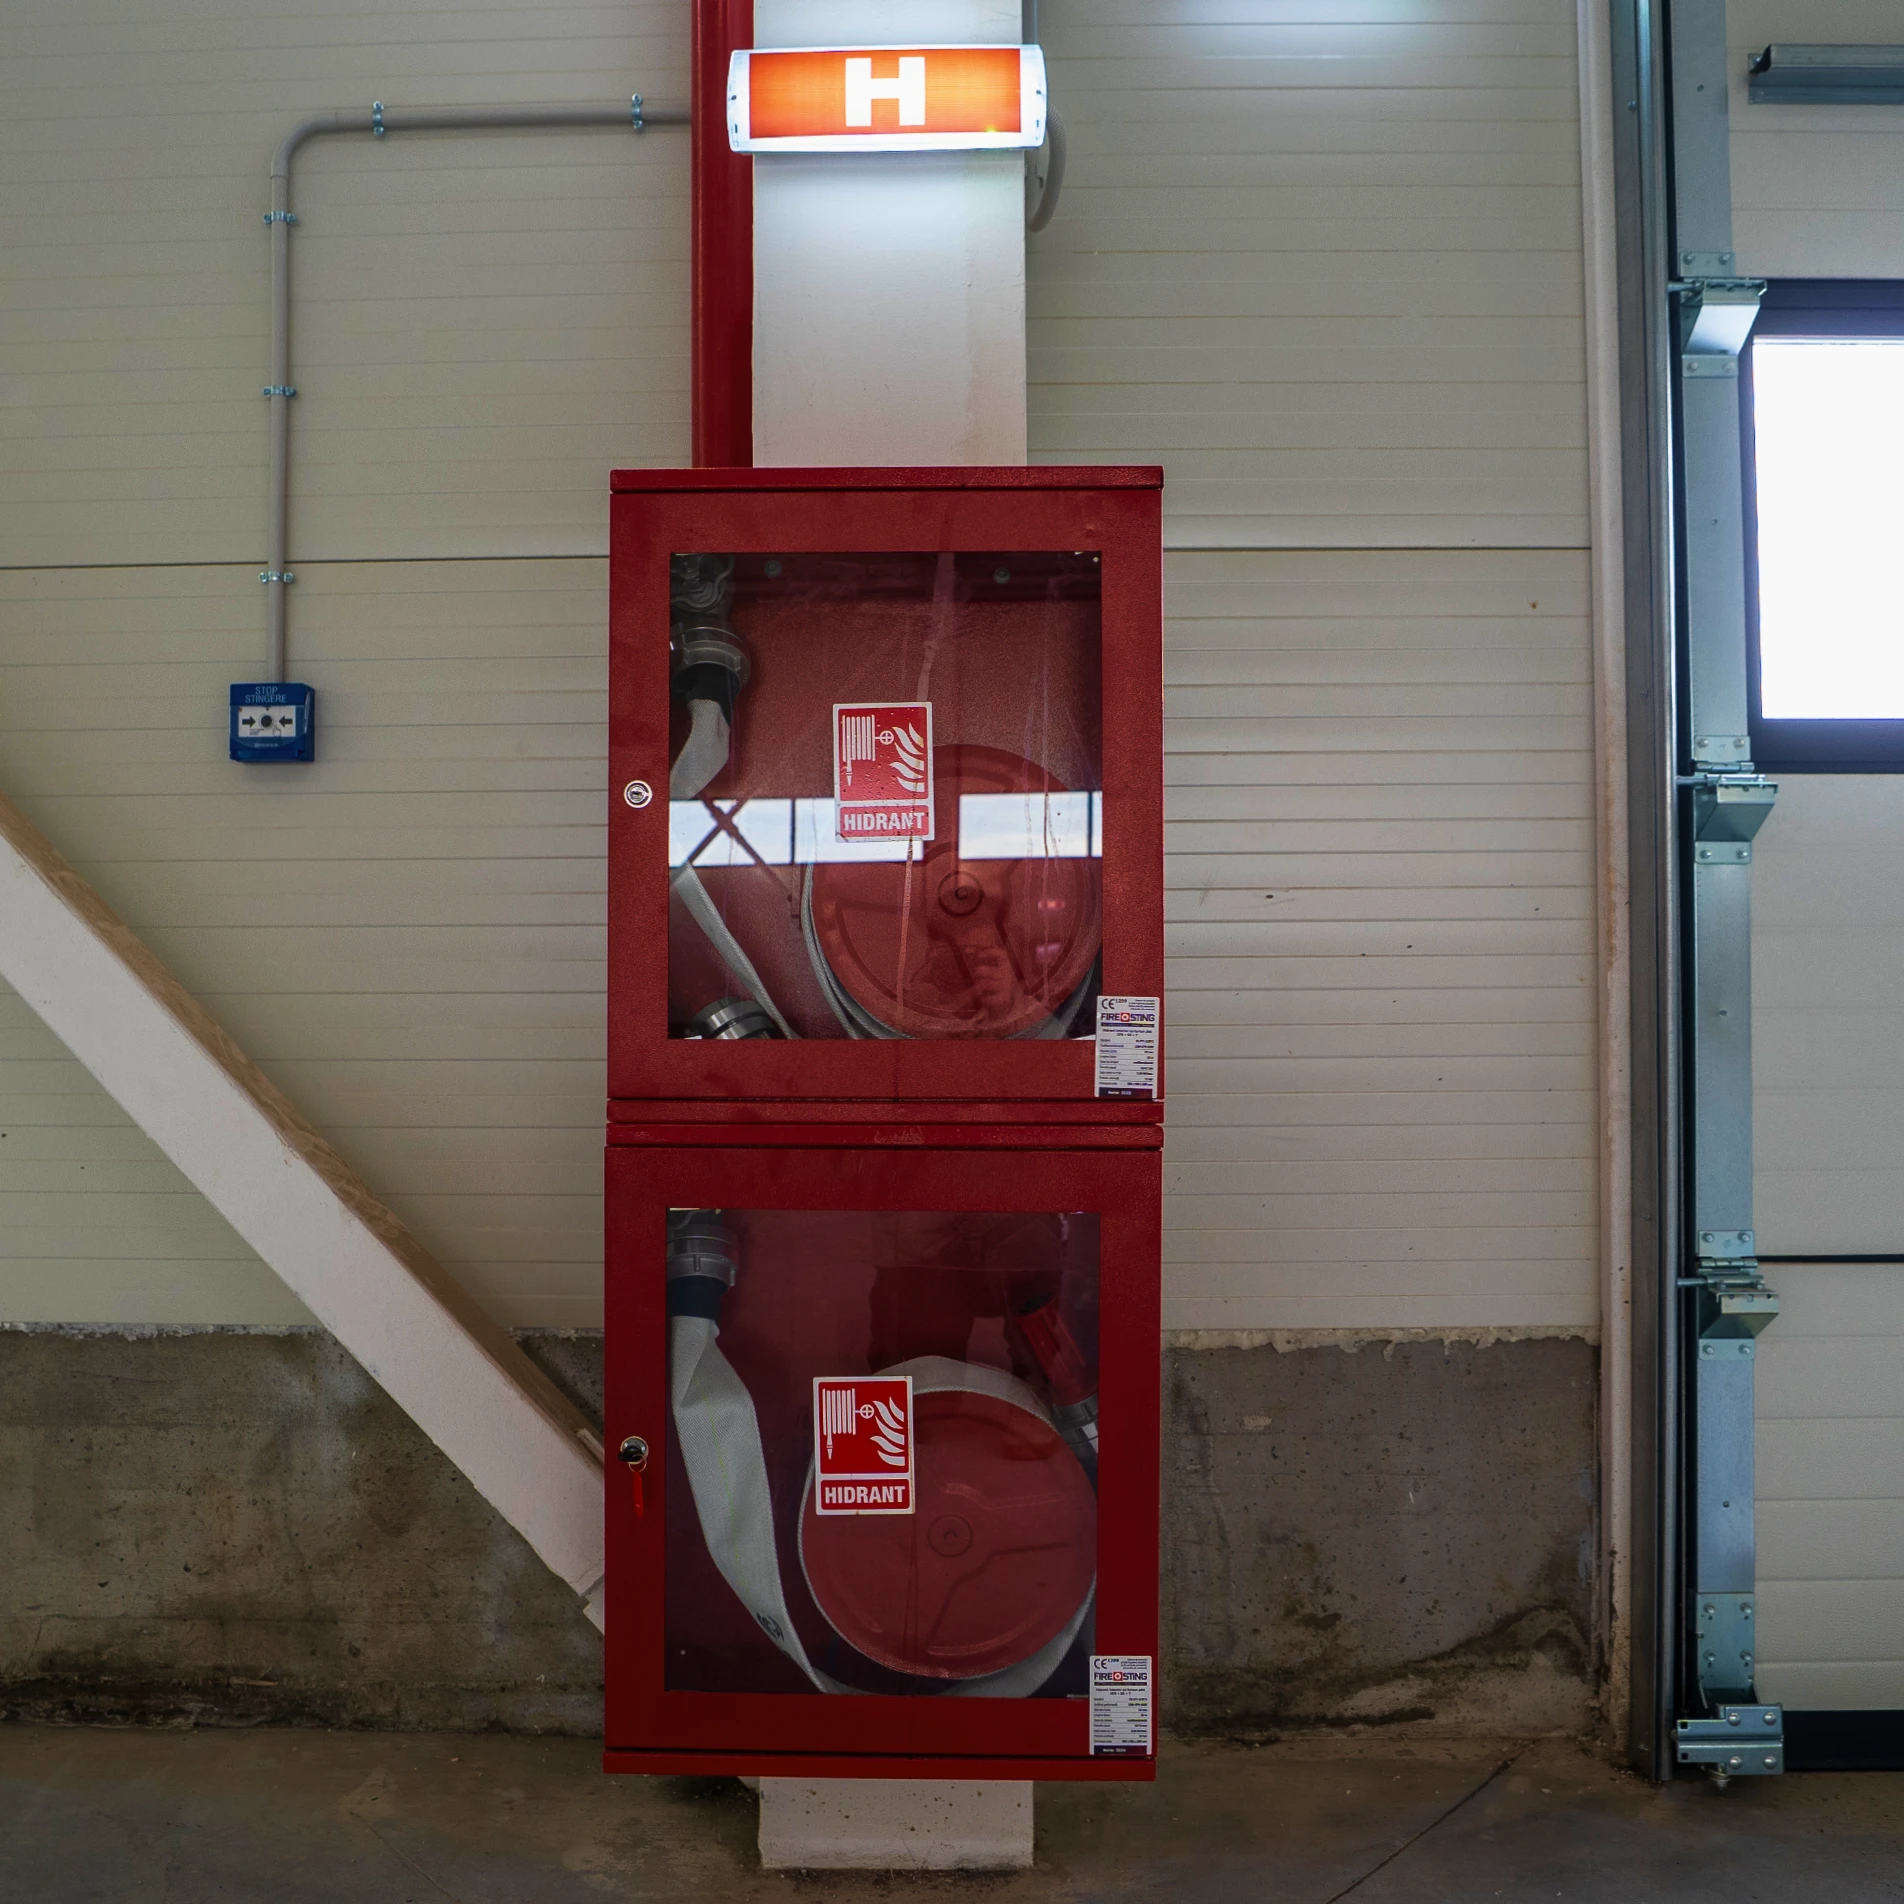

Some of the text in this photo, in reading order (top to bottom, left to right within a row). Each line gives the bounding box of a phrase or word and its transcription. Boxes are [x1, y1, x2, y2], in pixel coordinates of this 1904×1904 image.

[844, 56, 926, 127] H
[245, 694, 287, 703] STINGERE
[255, 686, 278, 695] STOP
[844, 812, 925, 831] HIDRANT
[824, 1486, 905, 1504] HIDRANT
